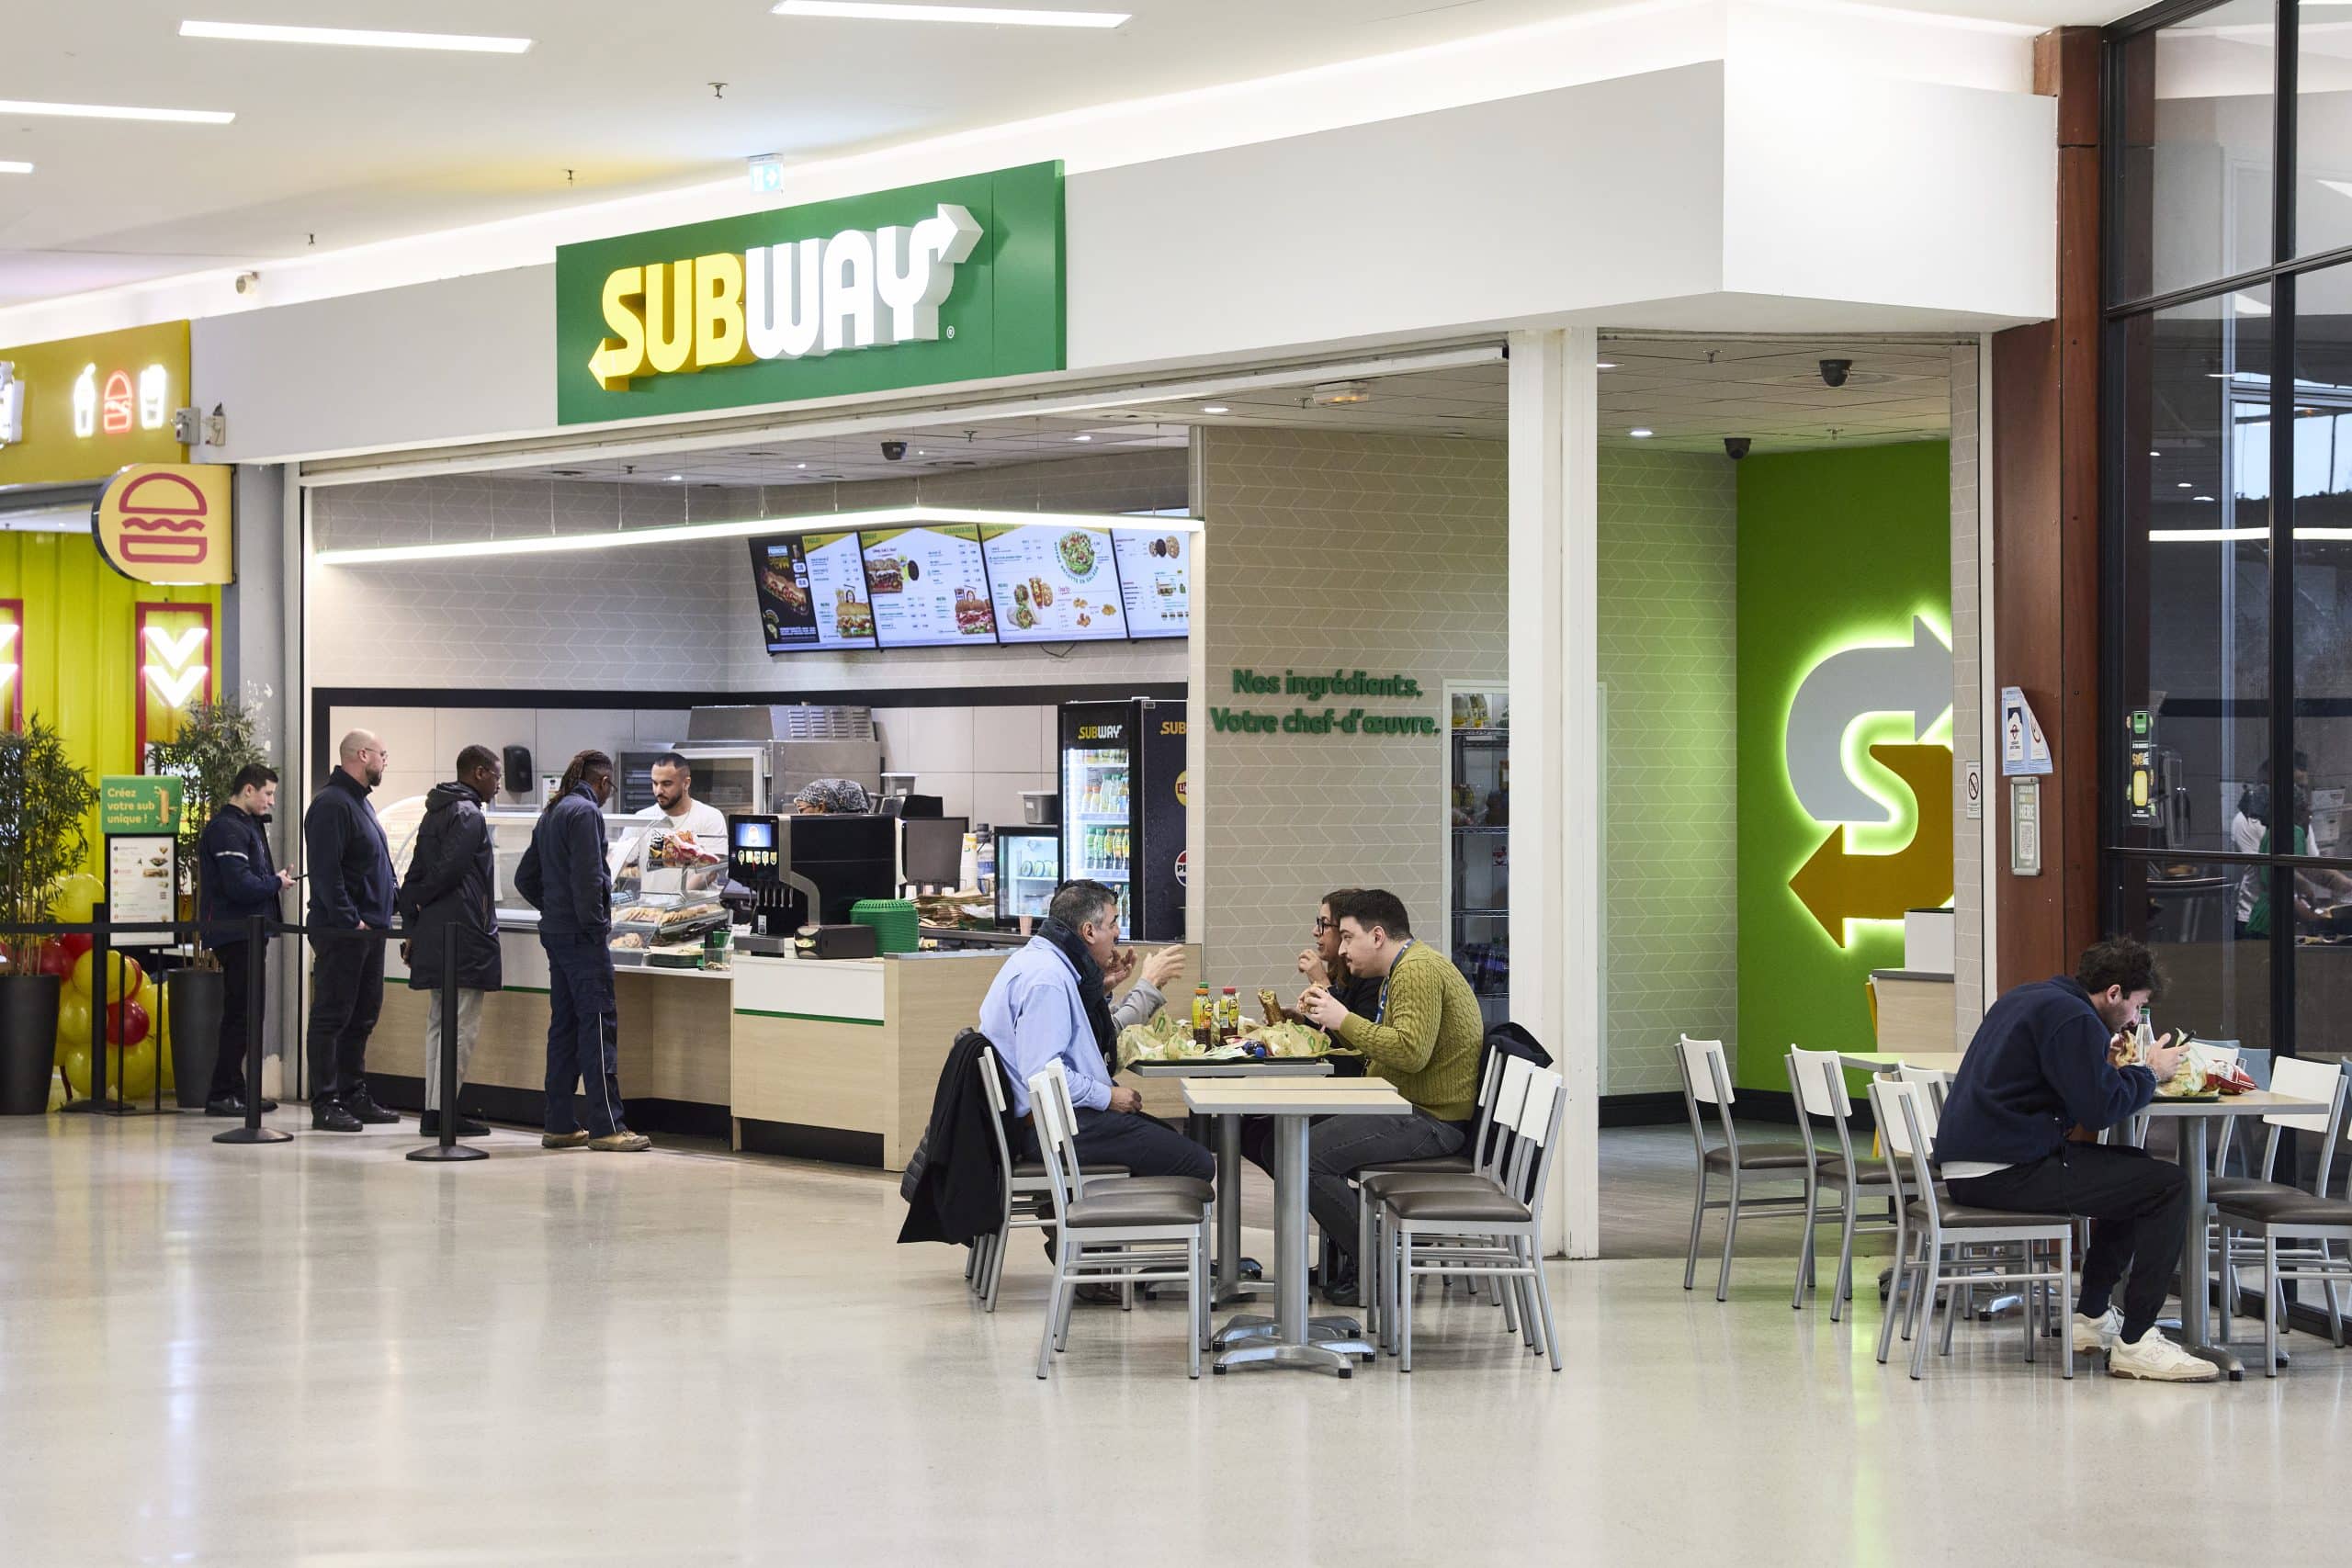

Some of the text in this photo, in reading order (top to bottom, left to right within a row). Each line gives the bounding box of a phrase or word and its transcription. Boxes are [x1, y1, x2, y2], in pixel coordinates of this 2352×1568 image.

[588, 203, 984, 391] SUBWAY
[1232, 669, 1424, 701] Nos ingrédients.
[1209, 706, 1279, 734] Votre
[1078, 725, 1123, 740] SUBWAY
[1159, 721, 1186, 736] SUB
[107, 787, 137, 798] Créez
[107, 801, 155, 811] votre sub
[107, 814, 142, 826] unique
